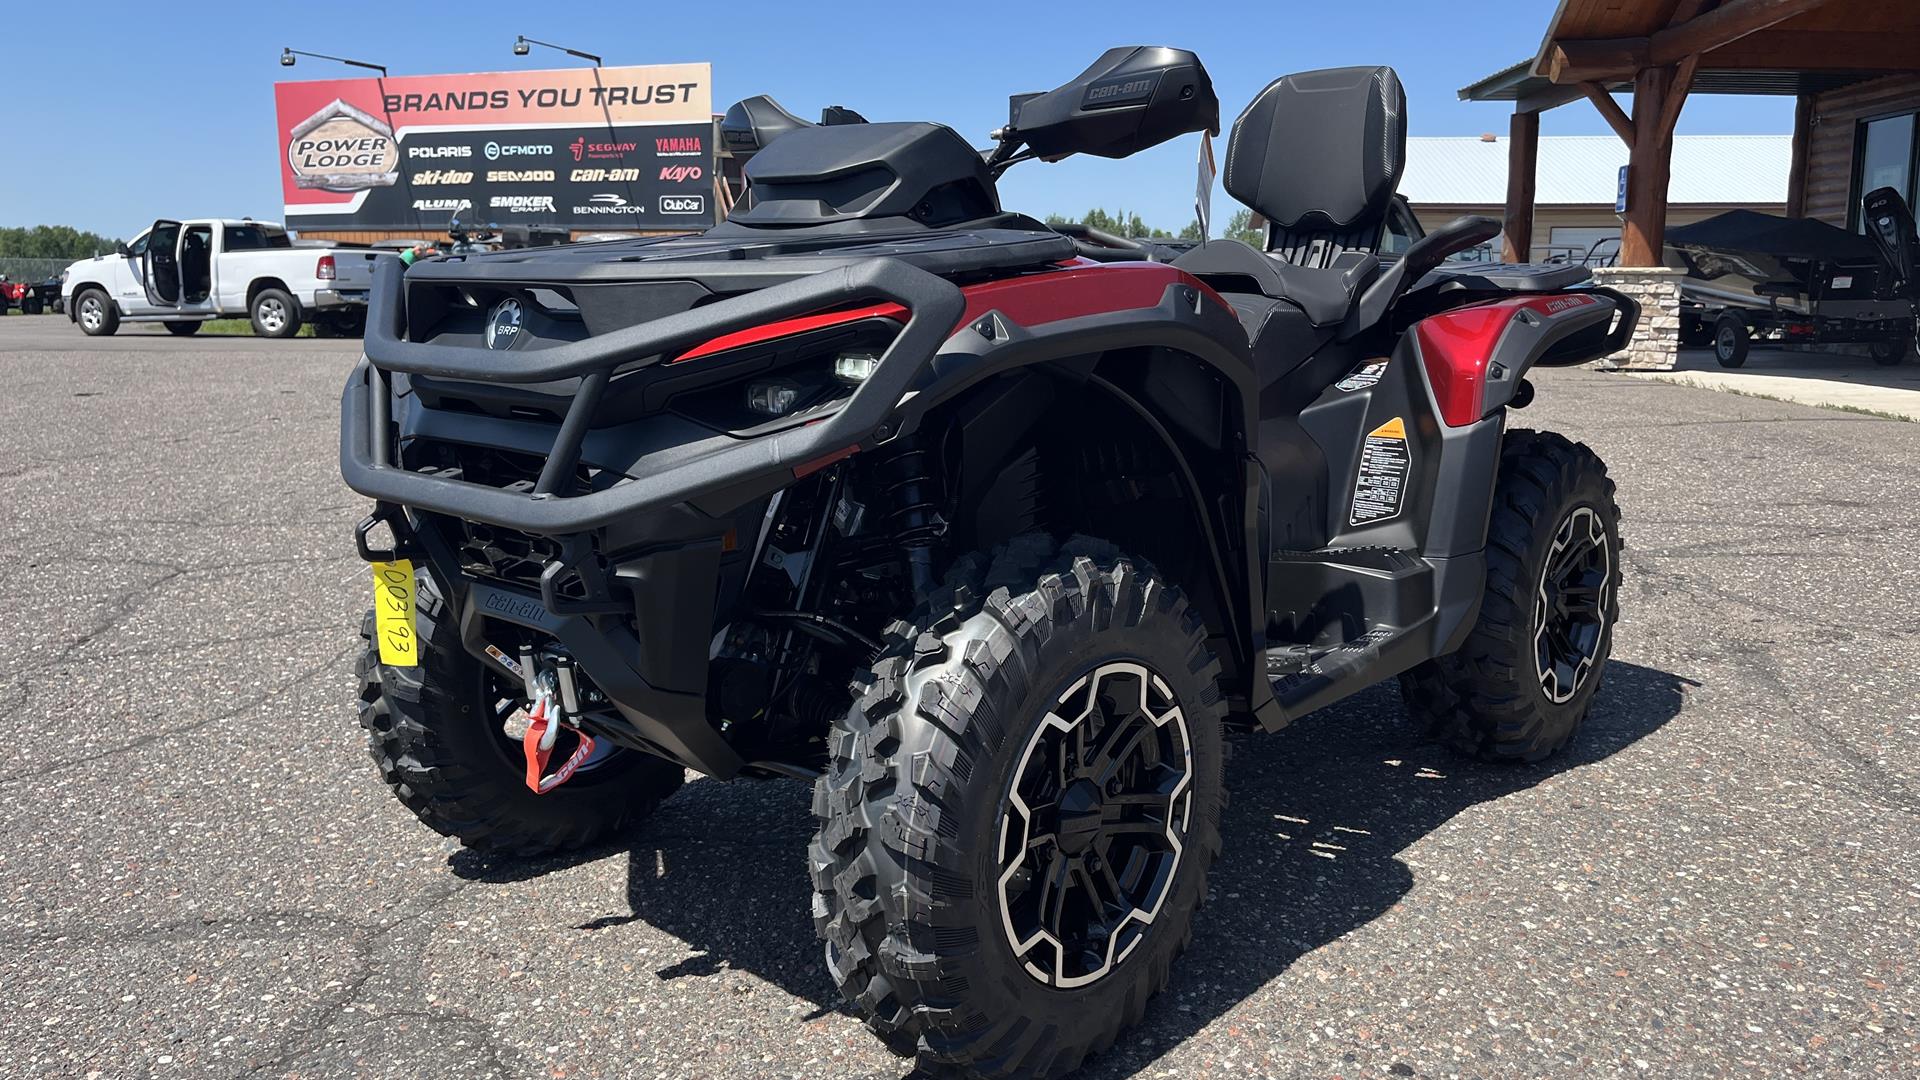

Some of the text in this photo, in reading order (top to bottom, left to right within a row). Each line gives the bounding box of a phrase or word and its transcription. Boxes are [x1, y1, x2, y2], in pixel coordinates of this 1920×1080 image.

[1089, 80, 1150, 99] can-am
[384, 83, 698, 112] BRANDS YOU TRUST
[298, 138, 387, 155] POWER
[408, 146, 472, 158] POLARIS
[501, 145, 553, 156] CFMOTO
[588, 143, 637, 152] SEGWAY
[655, 137, 701, 152] YAMAHA
[303, 153, 385, 168] LODGE
[412, 170, 474, 186] ski-doo
[570, 168, 640, 182] can-am
[659, 164, 702, 182] KAYO
[412, 199, 472, 210] ALUMA
[490, 196, 556, 212] SMOKER
[573, 206, 645, 214] BENNINGTON
[497, 325, 519, 335] BRP
[383, 567, 411, 654] 003193
[485, 592, 546, 622] can-am
